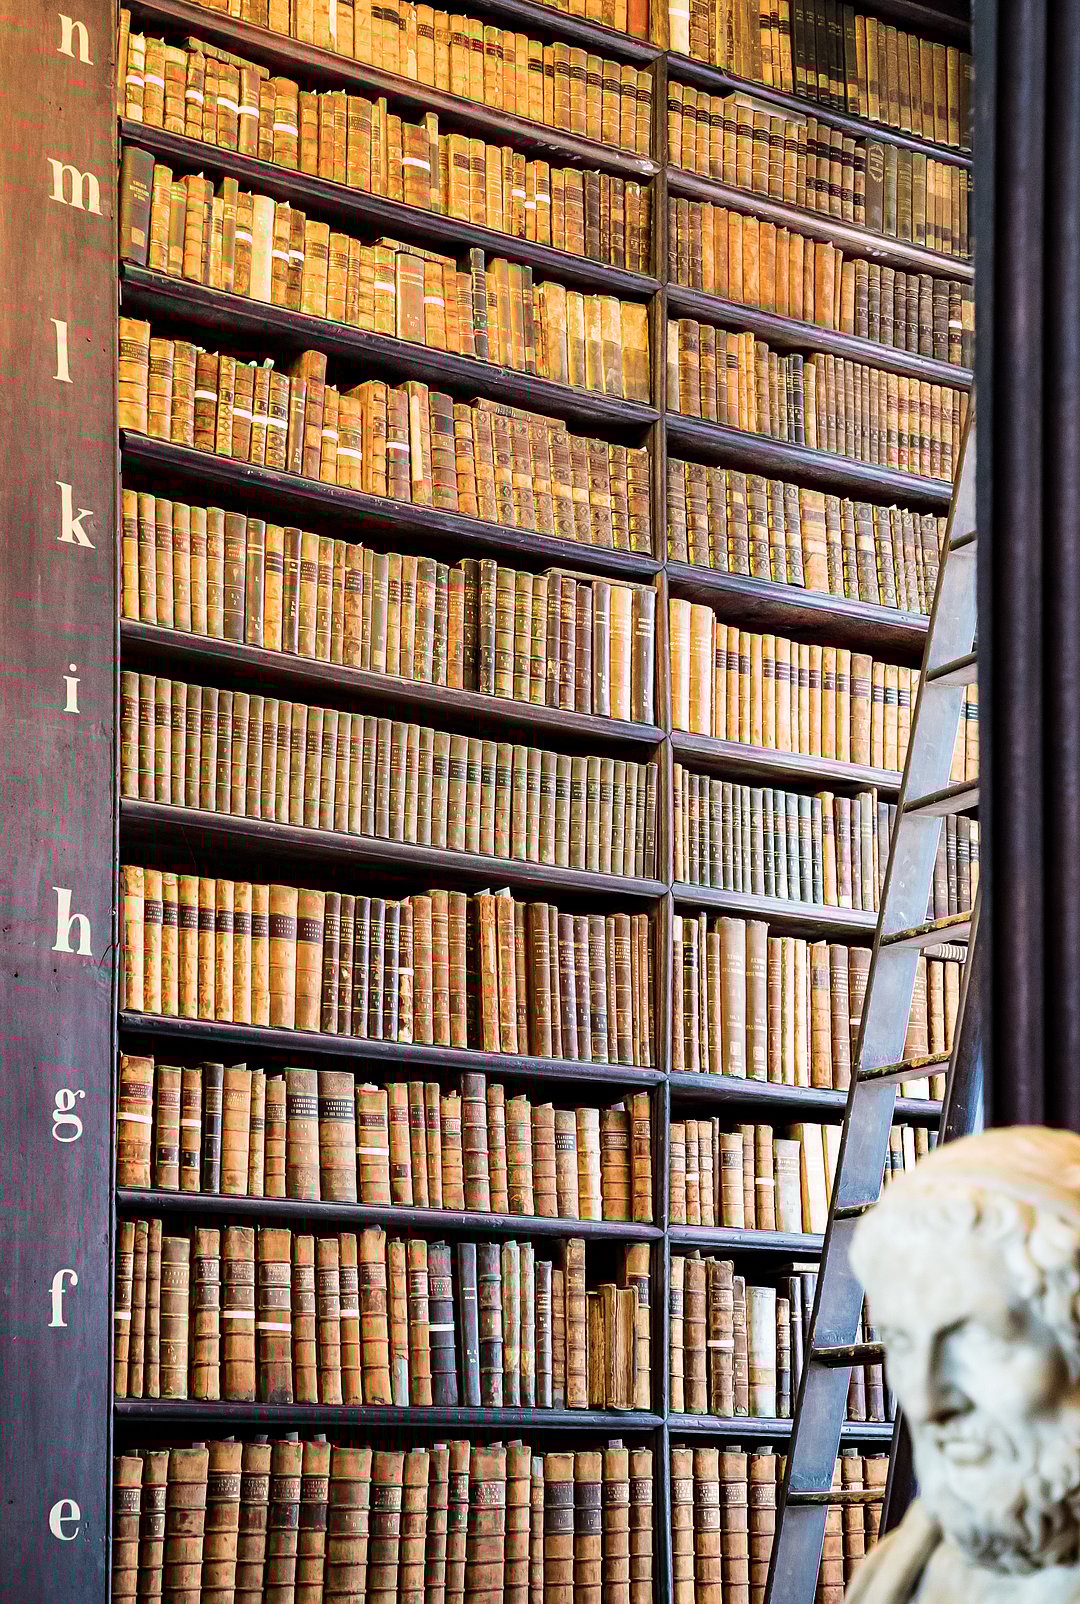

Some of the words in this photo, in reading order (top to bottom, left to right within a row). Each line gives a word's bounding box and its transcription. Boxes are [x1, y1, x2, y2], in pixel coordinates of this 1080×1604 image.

[57, 13, 94, 66] n
[47, 157, 104, 216] m
[50, 317, 74, 384] l
[55, 480, 96, 550] k
[62, 663, 81, 714] i
[51, 886, 94, 957] h
[51, 1088, 86, 1143] g
[47, 1268, 79, 1328] f
[48, 1498, 81, 1541] e
